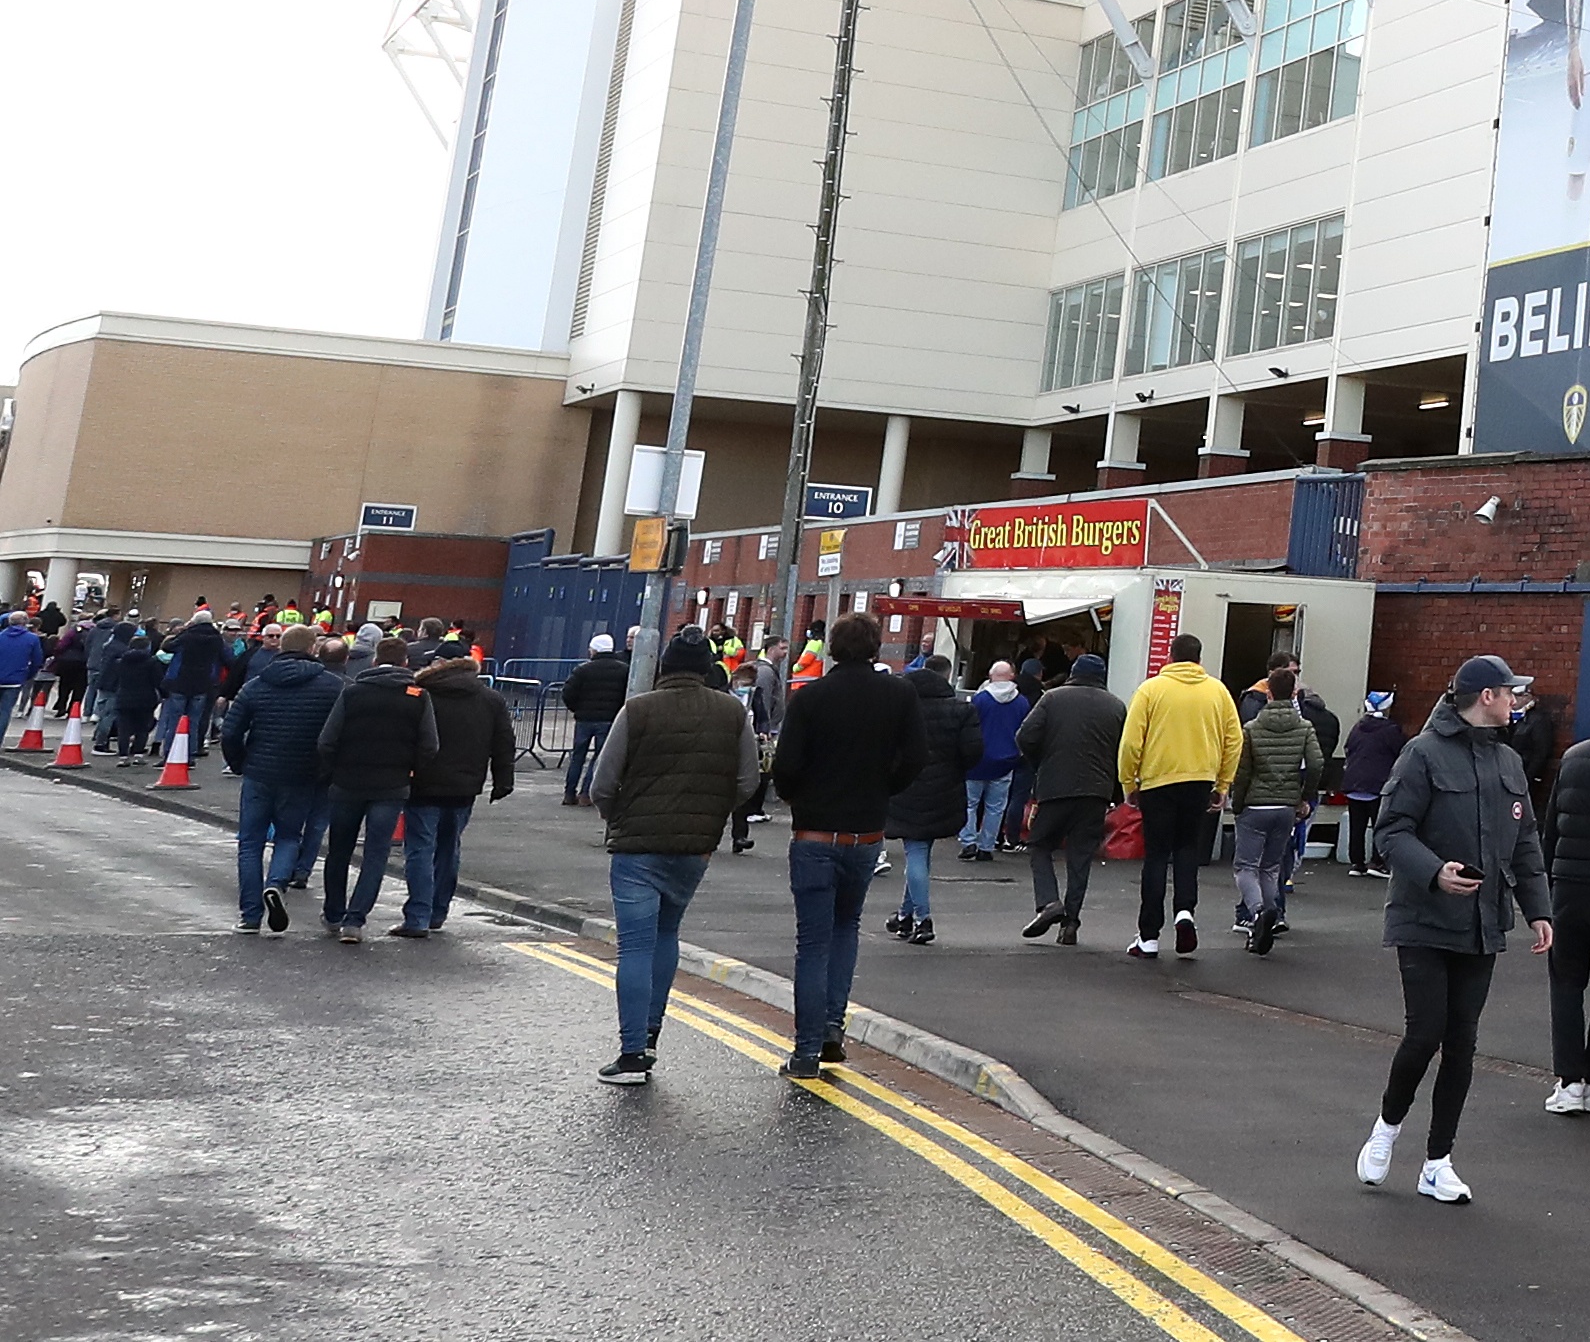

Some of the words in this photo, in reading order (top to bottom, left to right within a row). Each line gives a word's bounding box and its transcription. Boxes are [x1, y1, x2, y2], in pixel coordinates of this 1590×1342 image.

[814, 490, 860, 503] ENTRANCE
[371, 508, 406, 517] ENTRANCE
[827, 501, 844, 515] 10
[382, 516, 394, 525] 11
[969, 519, 1012, 550] Great
[1013, 514, 1068, 548] British
[1071, 514, 1141, 556] Burgers
